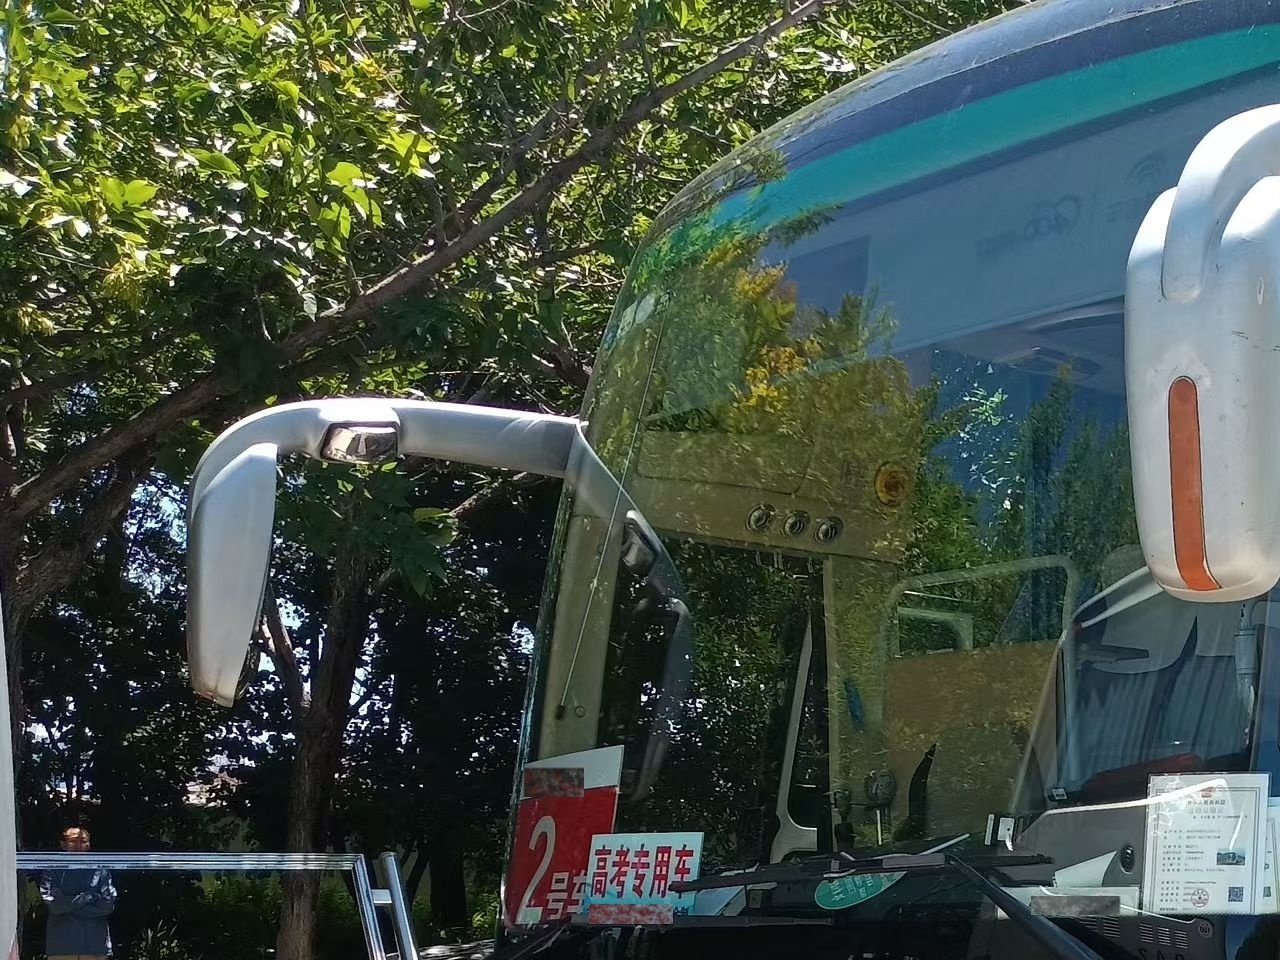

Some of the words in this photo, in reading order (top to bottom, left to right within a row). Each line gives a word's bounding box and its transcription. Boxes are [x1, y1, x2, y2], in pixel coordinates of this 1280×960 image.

[590, 843, 694, 900] 高考专用车
